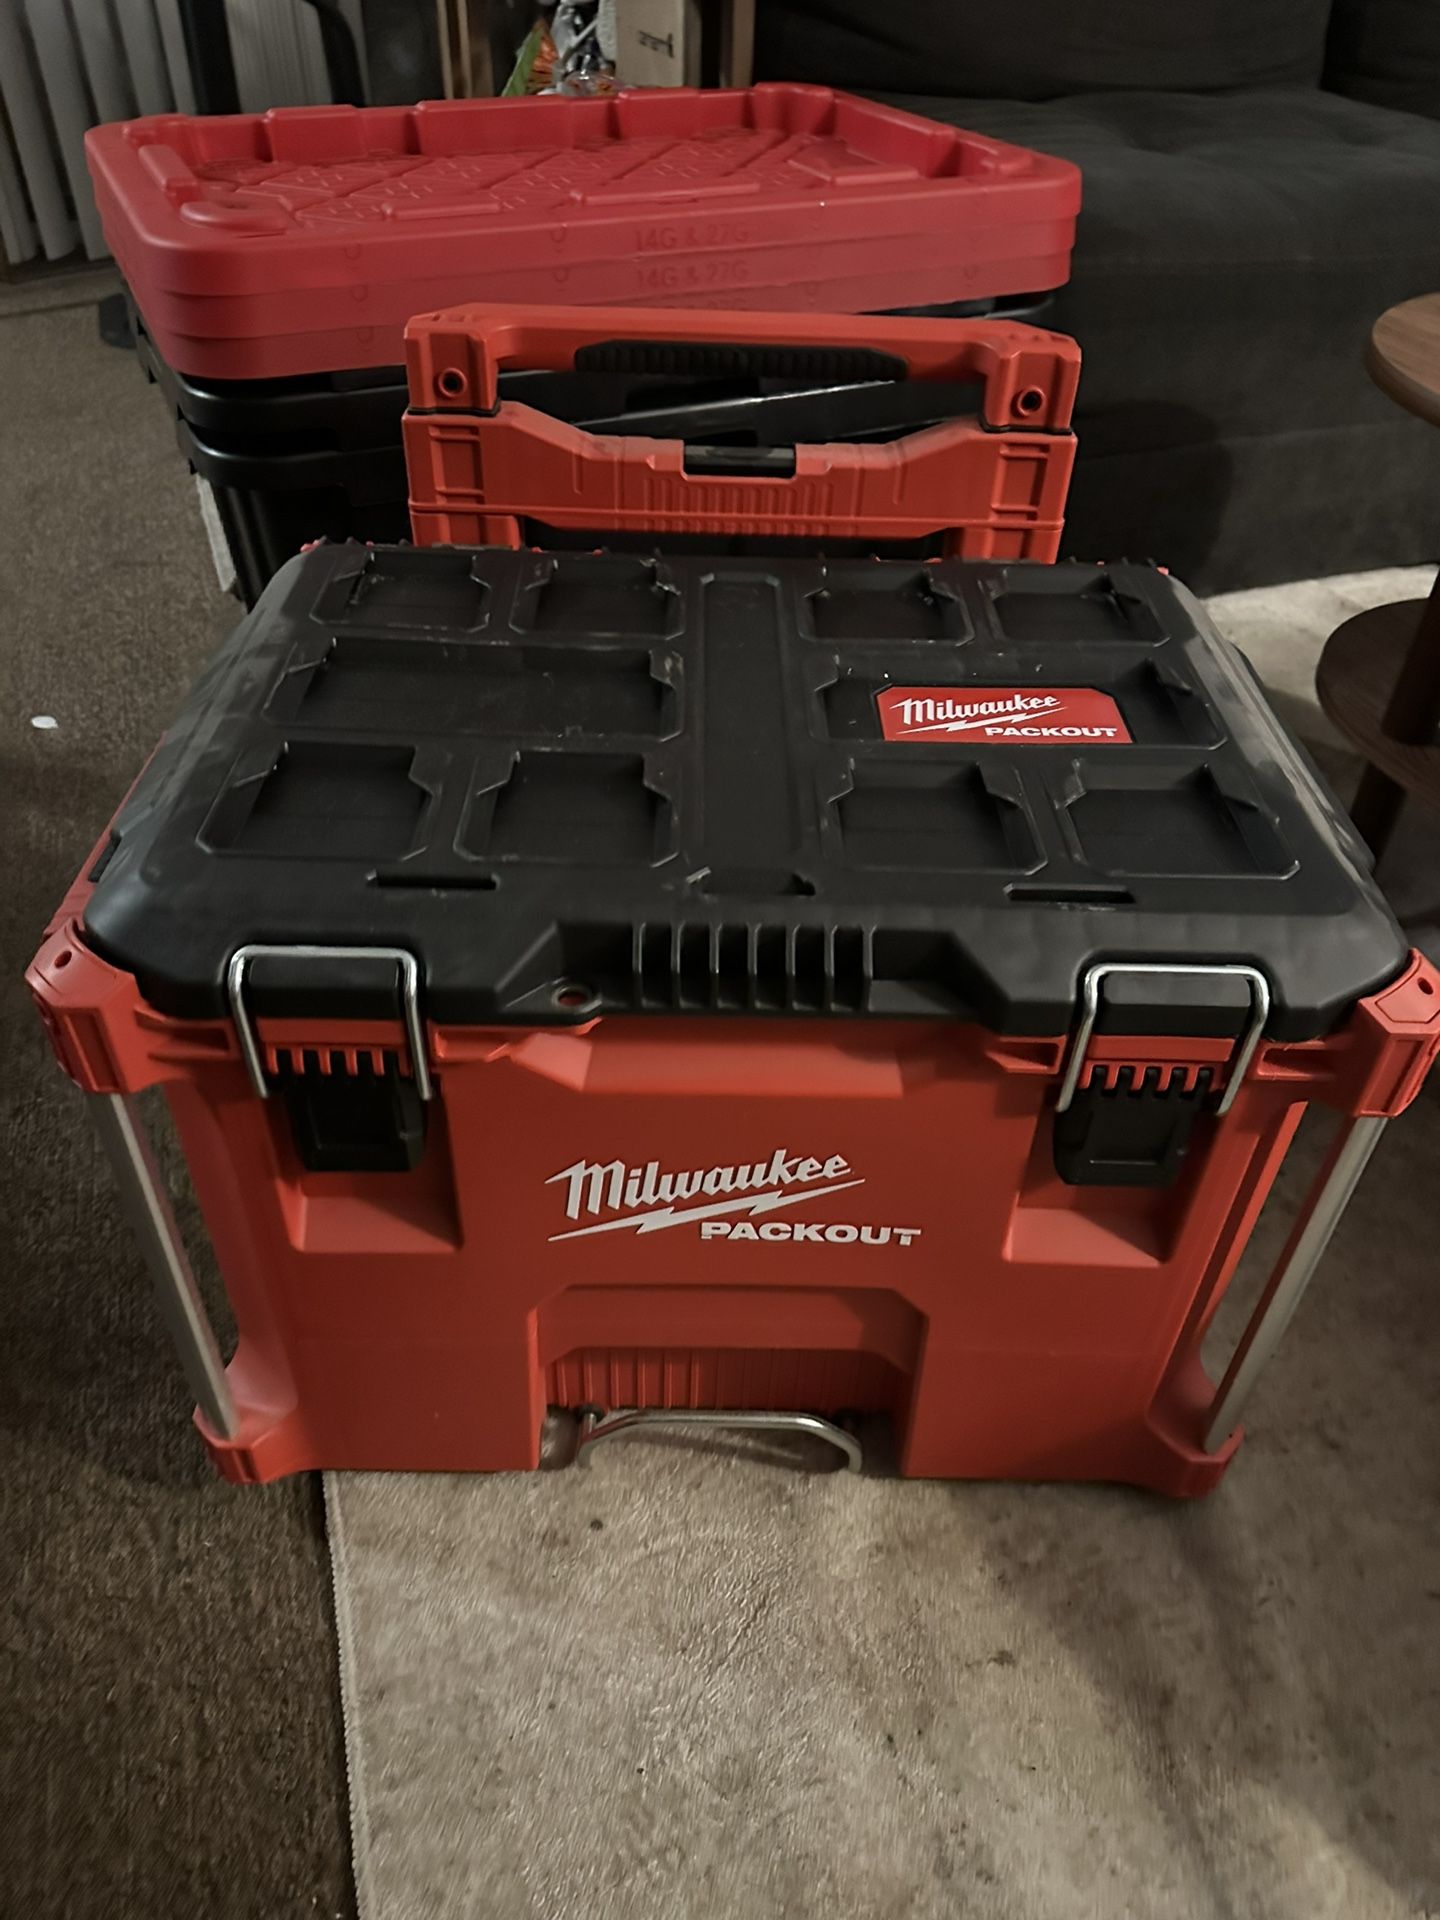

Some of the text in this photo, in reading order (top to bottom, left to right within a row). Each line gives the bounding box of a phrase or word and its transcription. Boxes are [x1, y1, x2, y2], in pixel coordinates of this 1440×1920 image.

[889, 694, 1061, 725] Milwaukee
[984, 726, 1117, 737] PACKOUT
[544, 1149, 851, 1220] Milwaukee
[700, 1221, 922, 1246] PACKOUT
